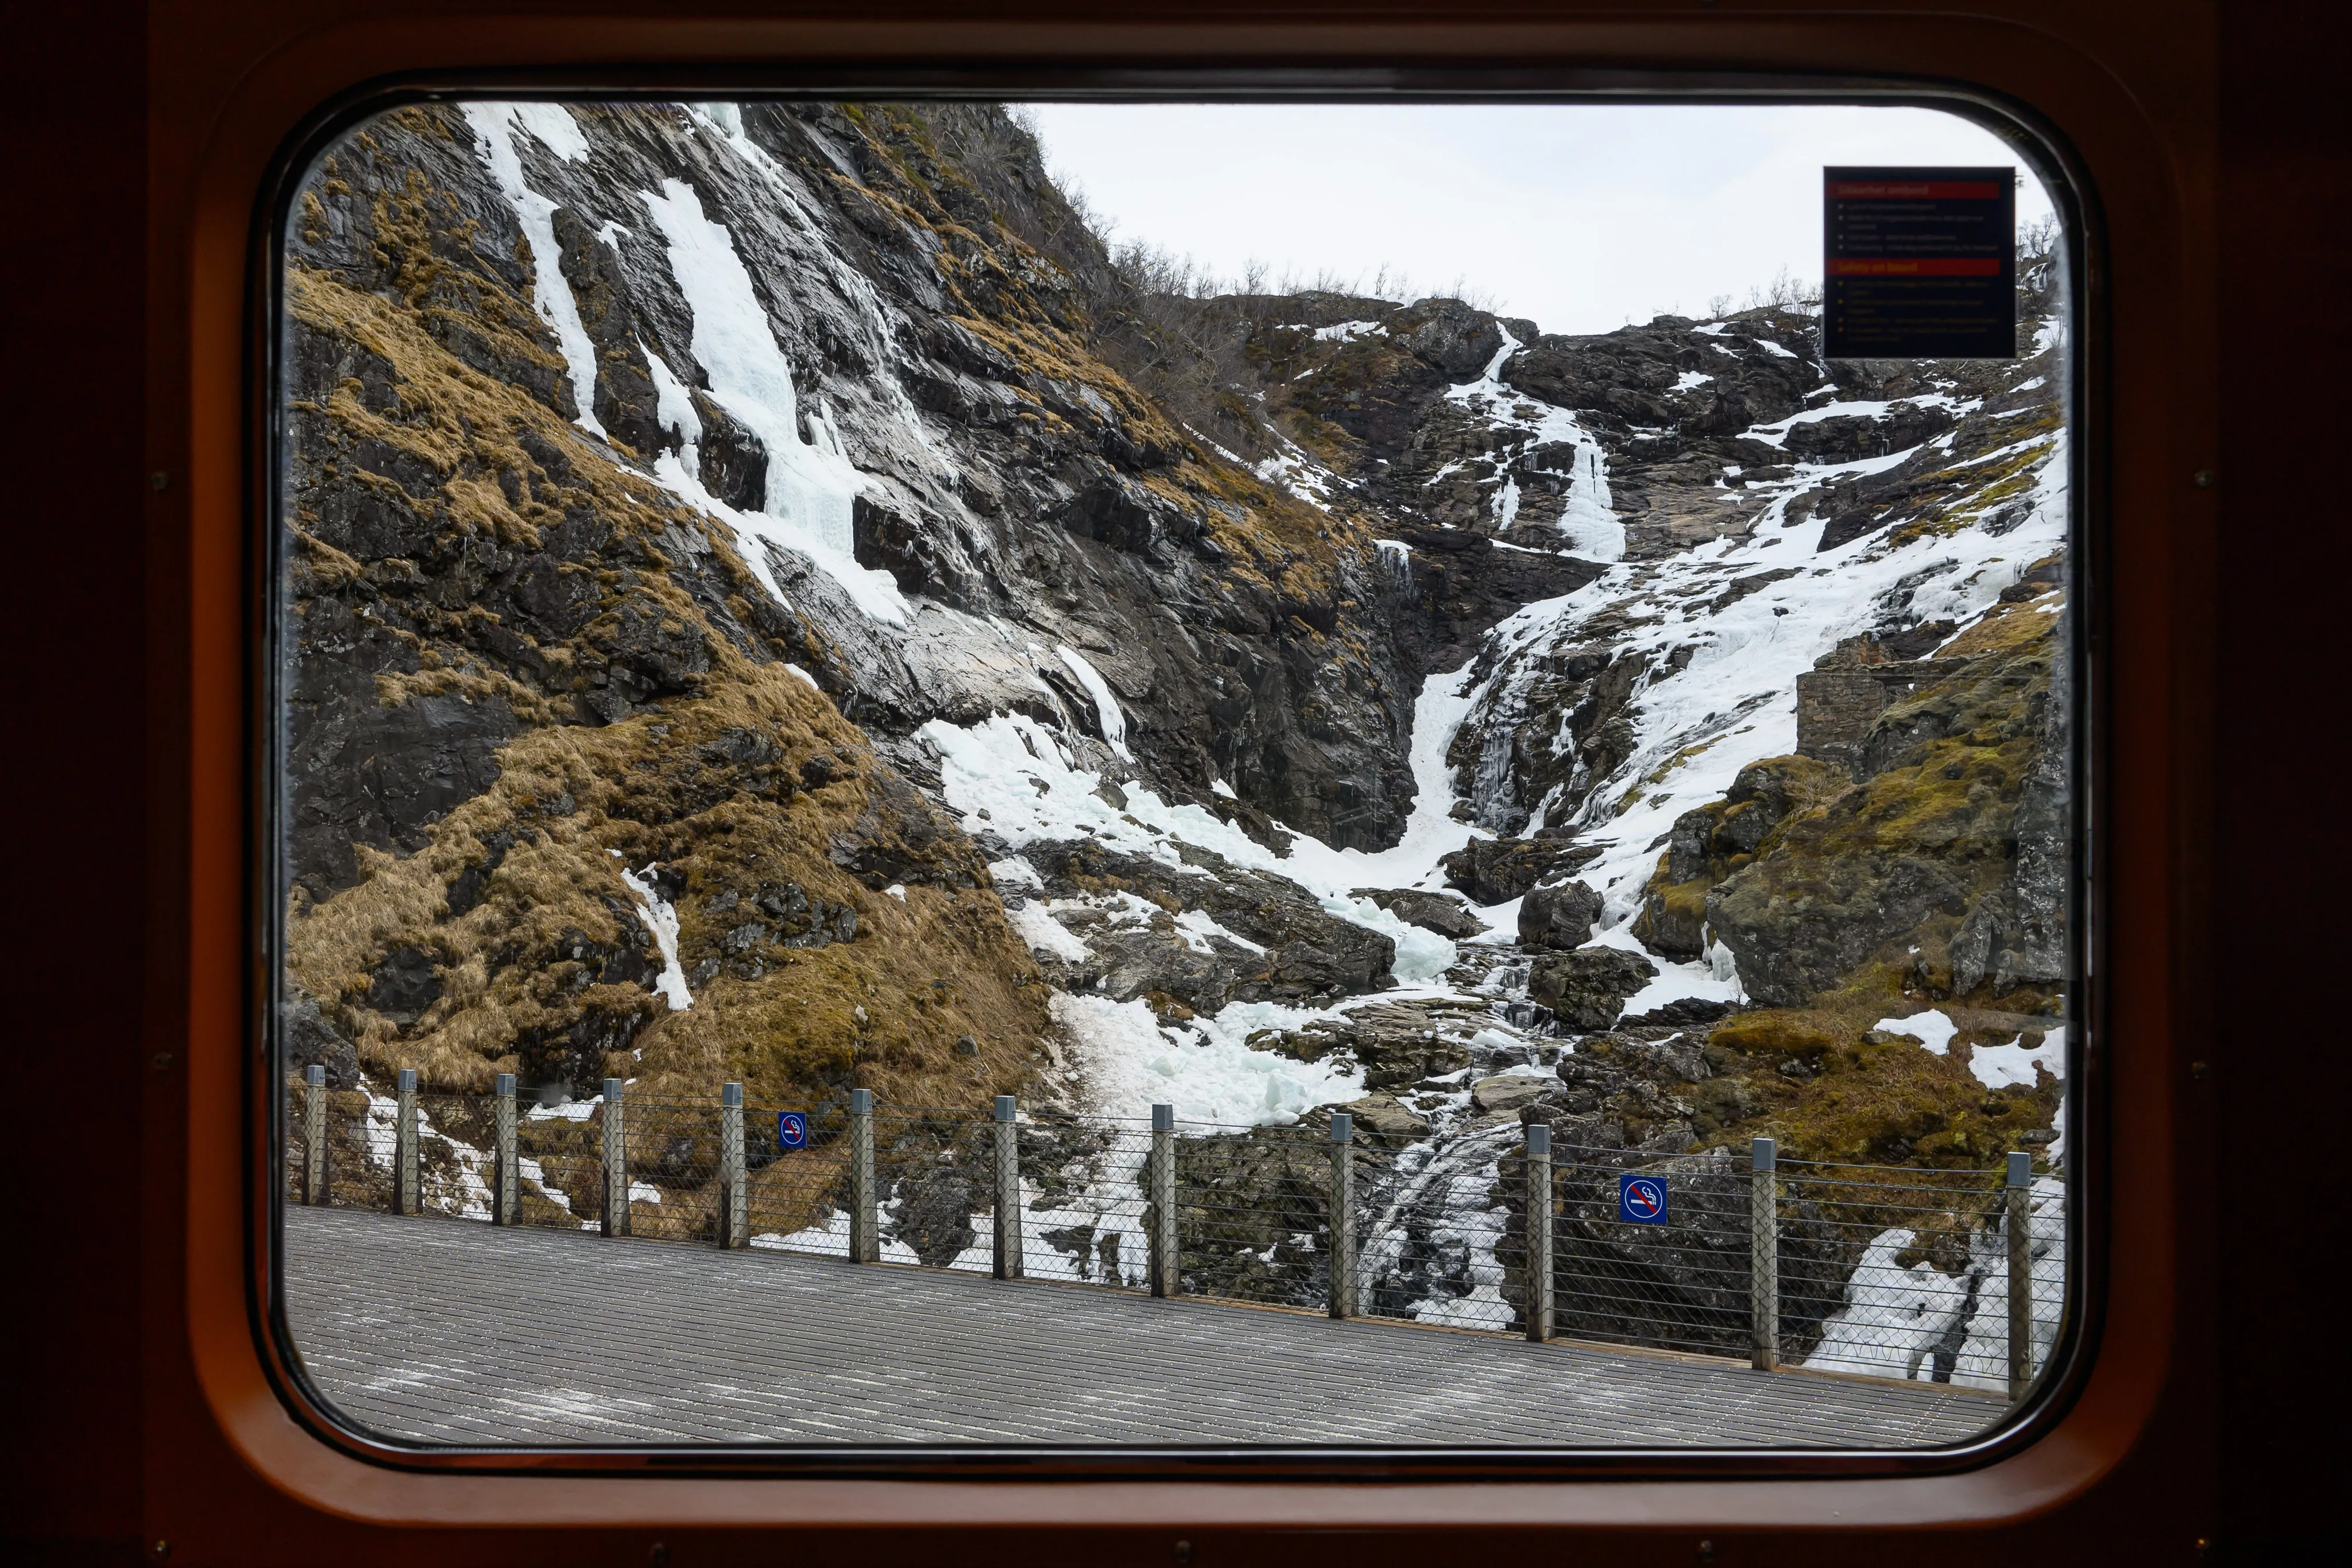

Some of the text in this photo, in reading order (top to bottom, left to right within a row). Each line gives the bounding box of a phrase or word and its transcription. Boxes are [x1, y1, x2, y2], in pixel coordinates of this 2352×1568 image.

[1838, 262, 1918, 273] Safety on board
